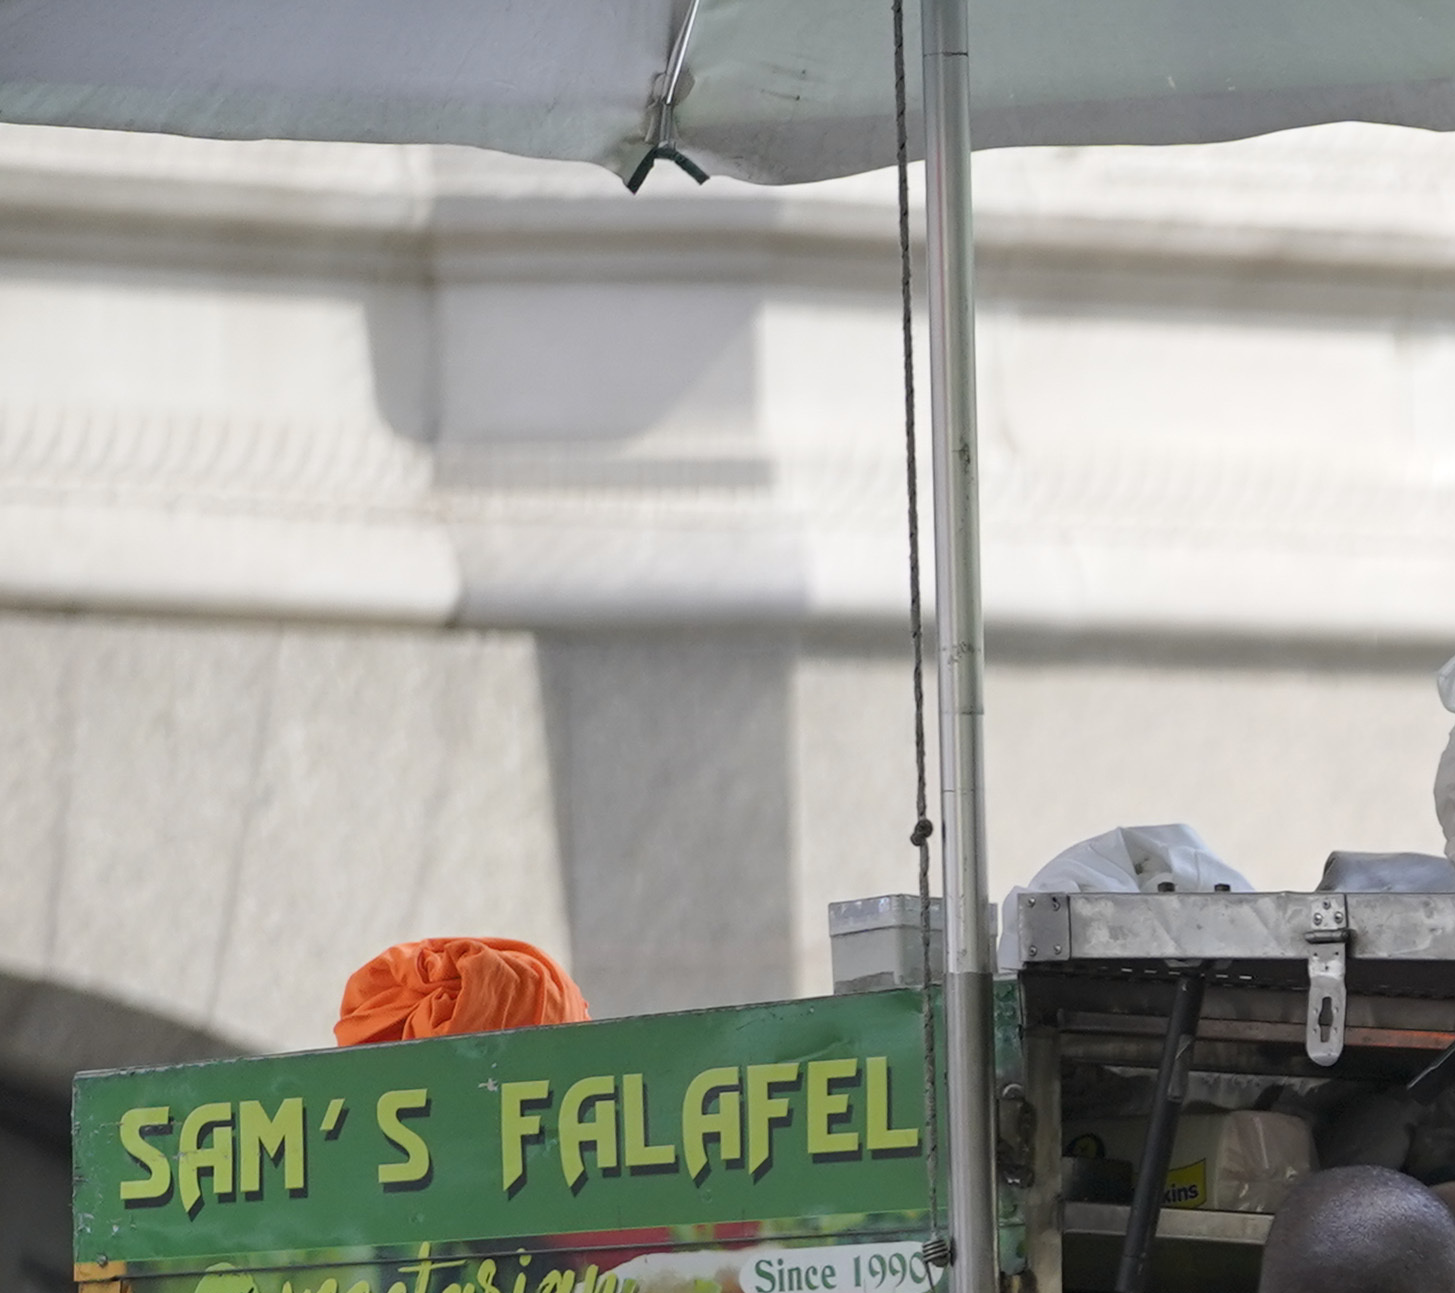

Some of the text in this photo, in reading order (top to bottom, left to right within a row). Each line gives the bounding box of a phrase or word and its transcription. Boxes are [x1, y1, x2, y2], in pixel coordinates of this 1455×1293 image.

[119, 1056, 921, 1216] SAM'S FALAFEL
[754, 1252, 927, 1293] Since 1990
